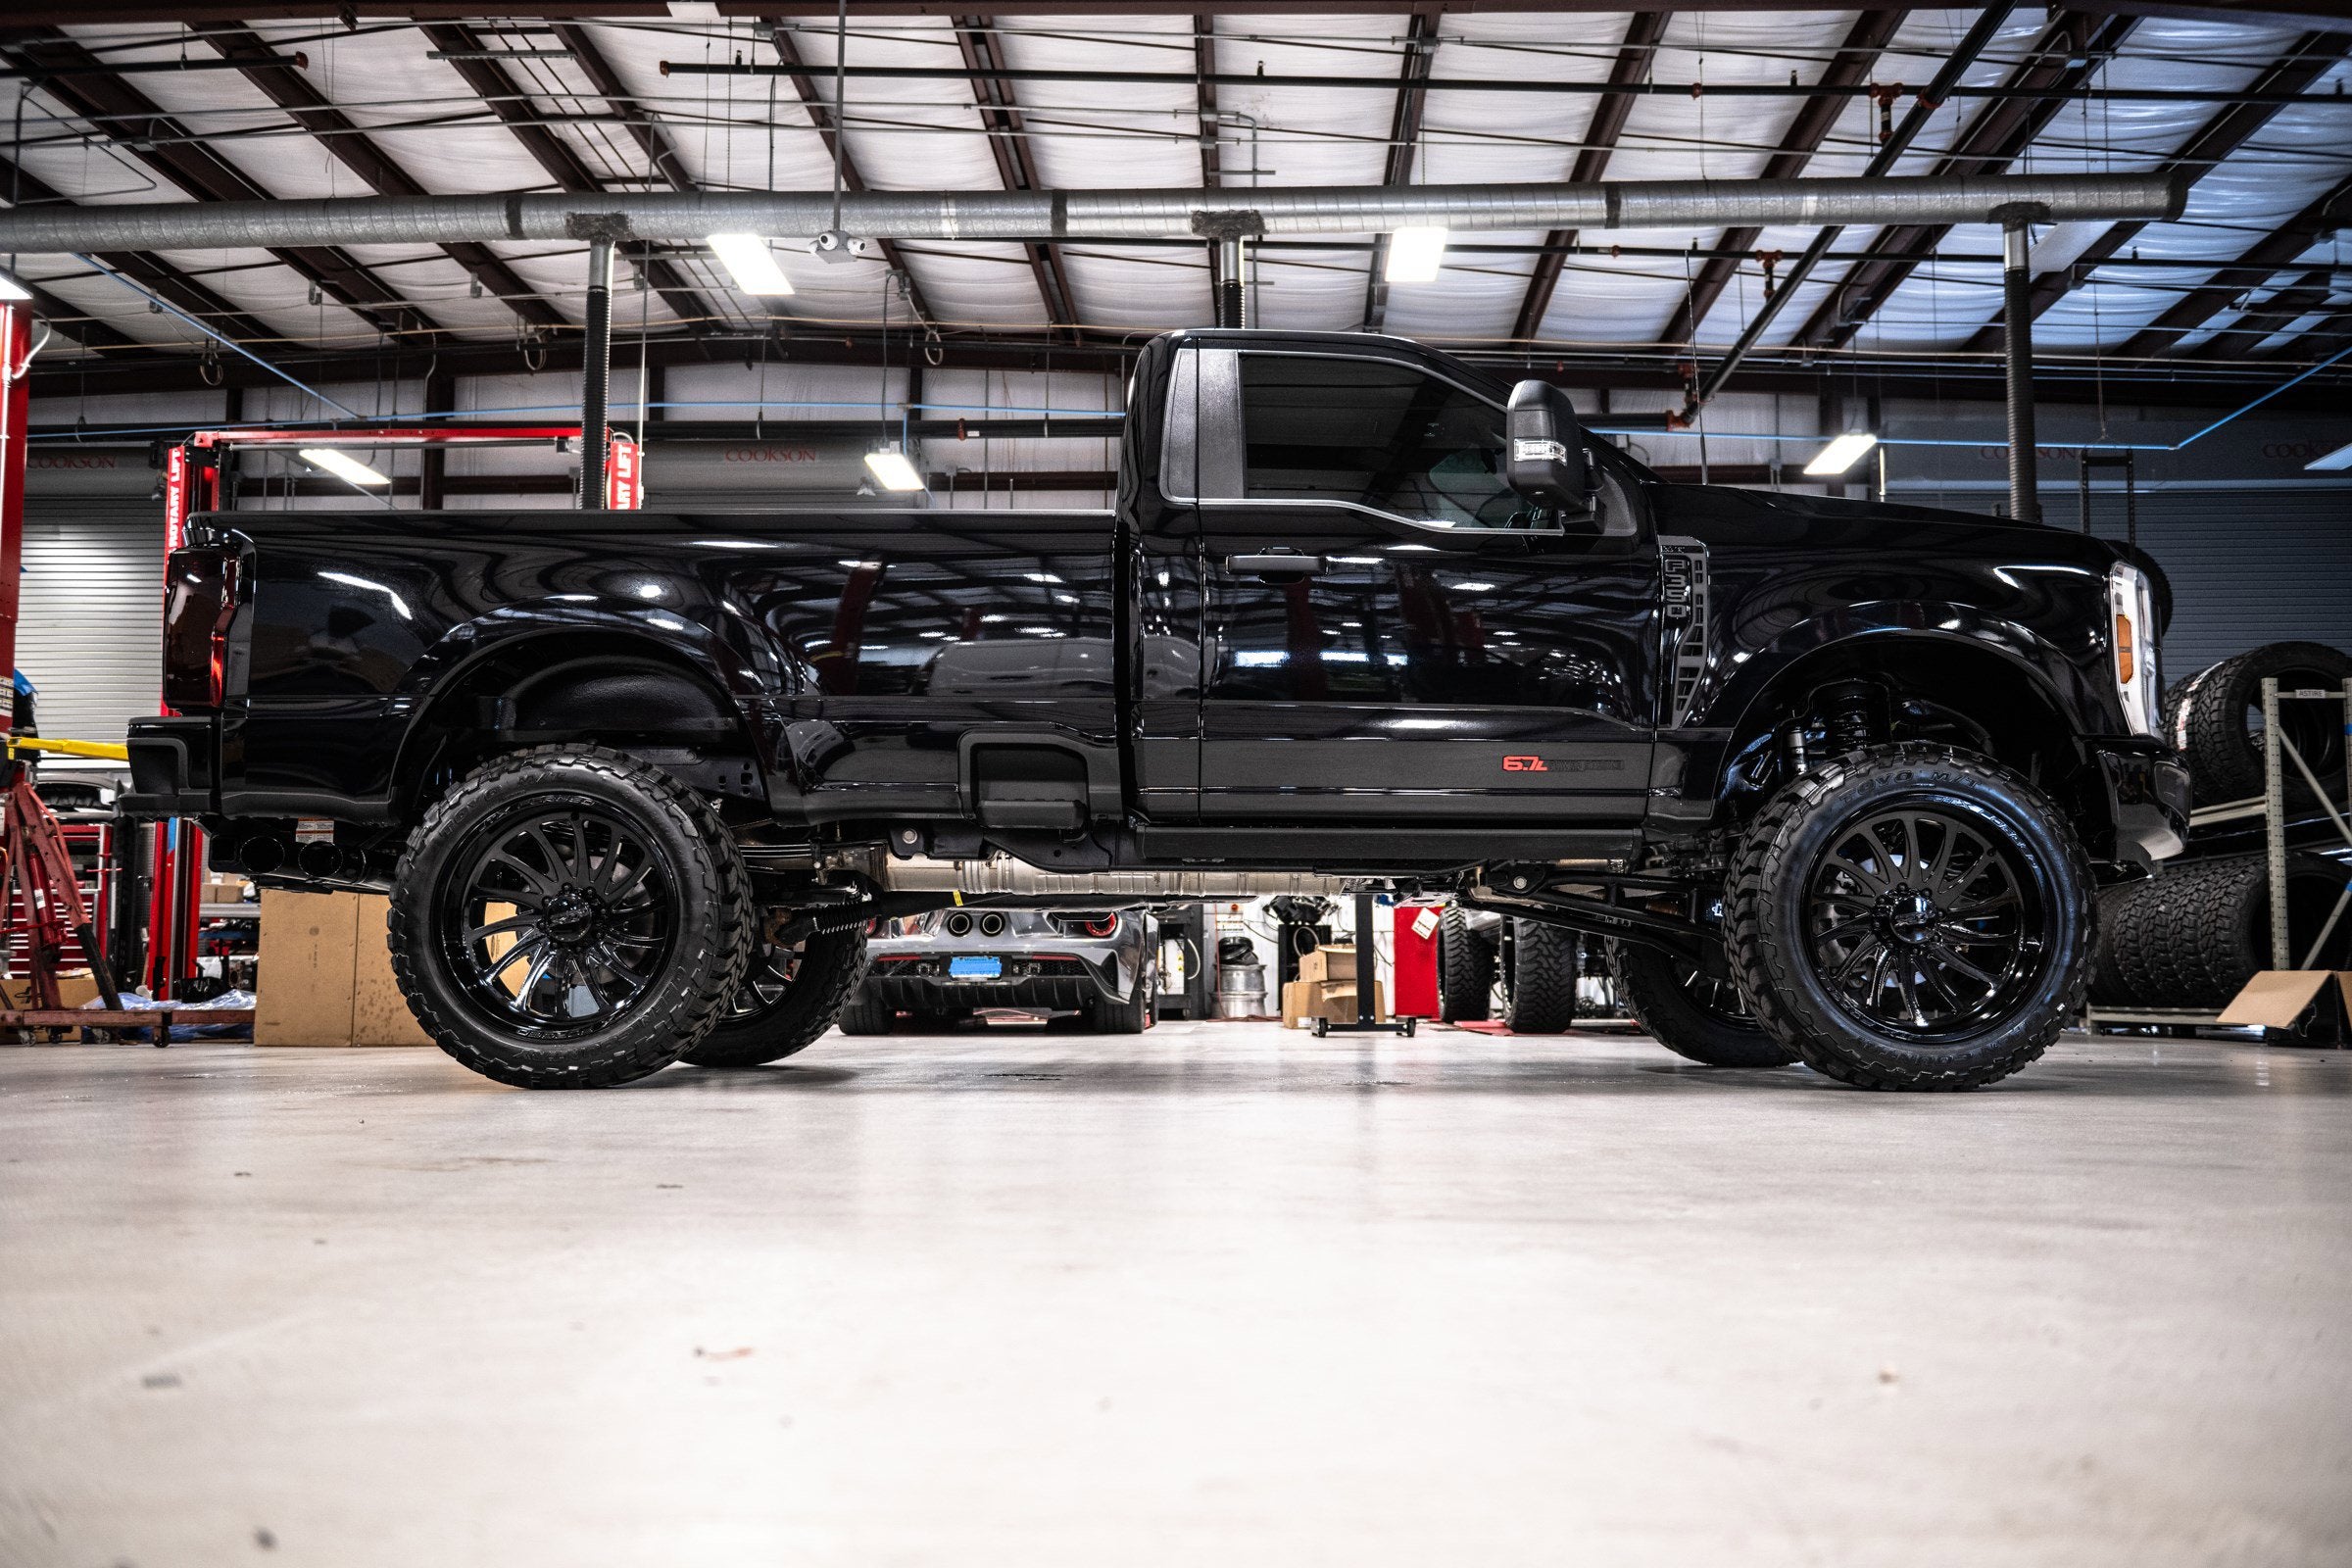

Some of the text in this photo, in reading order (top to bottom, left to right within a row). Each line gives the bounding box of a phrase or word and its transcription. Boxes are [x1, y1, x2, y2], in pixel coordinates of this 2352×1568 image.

[725, 447, 816, 462] COOKSON
[1981, 446, 2076, 459] COSON
[27, 455, 117, 468] COOKSON
[617, 444, 632, 510] ARY LIFT
[169, 448, 181, 548] ROTARY LIFT
[1502, 755, 1548, 771] 6.7L
[1838, 769, 1984, 808] TOYO M/T
